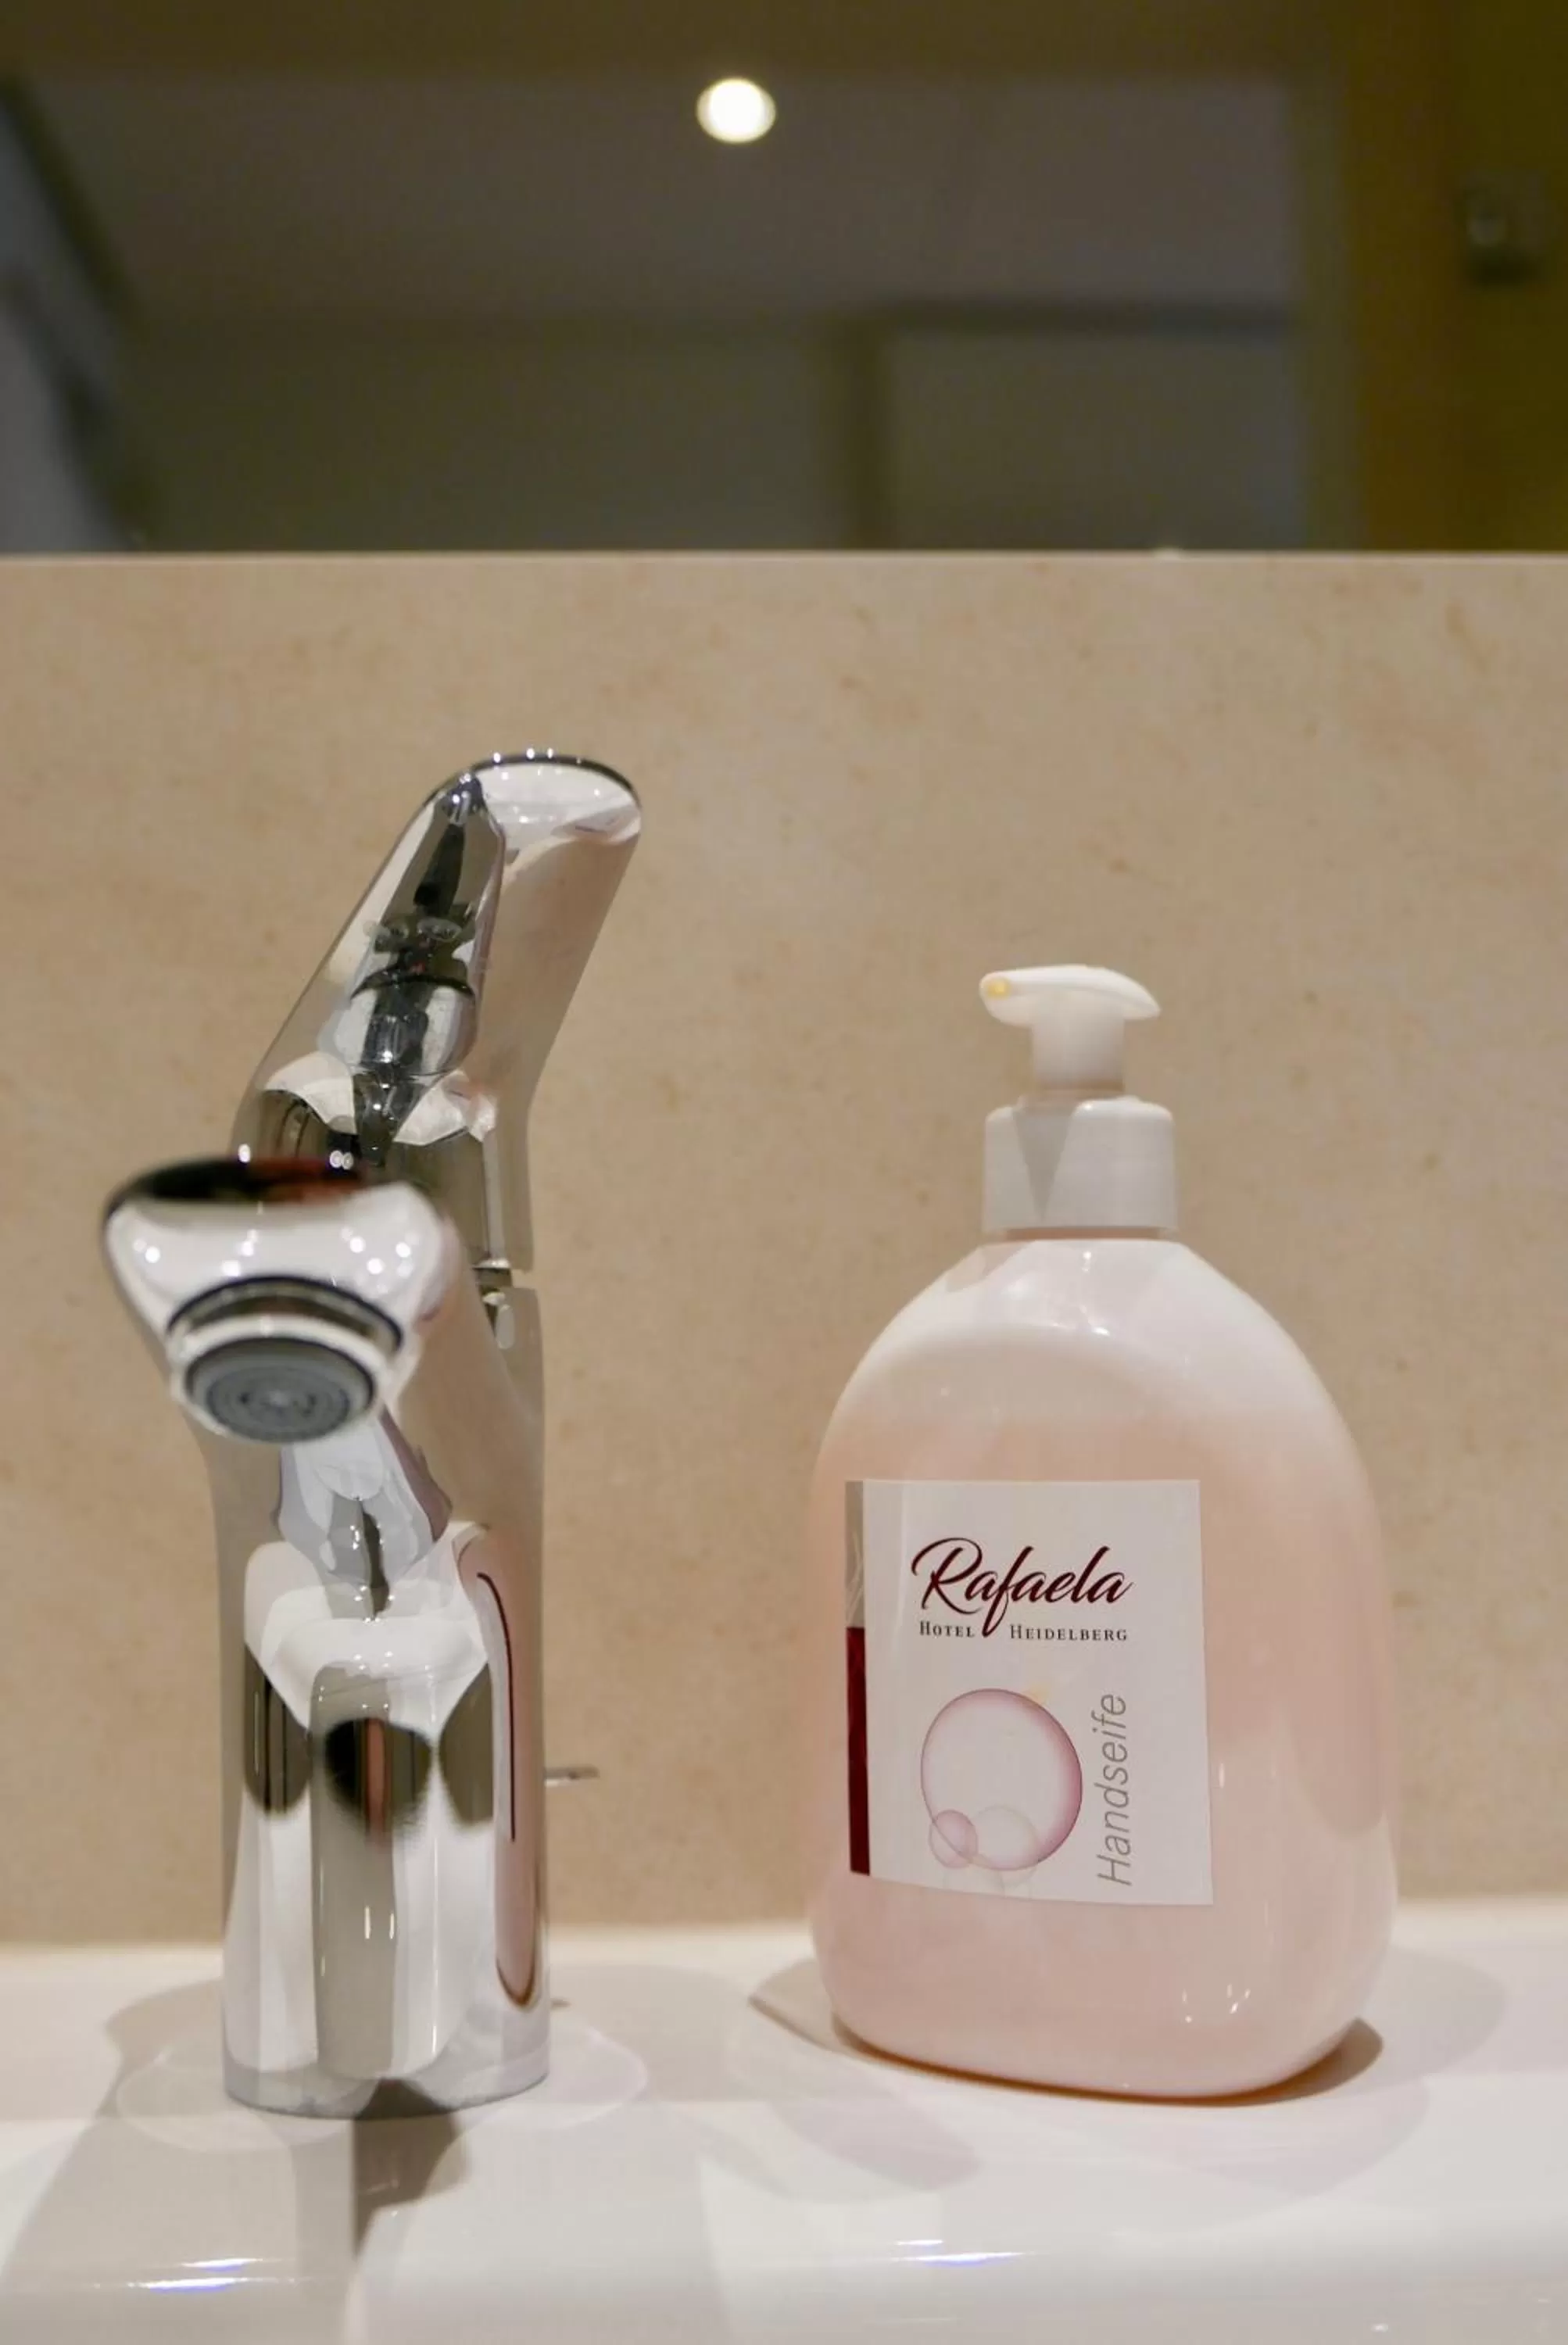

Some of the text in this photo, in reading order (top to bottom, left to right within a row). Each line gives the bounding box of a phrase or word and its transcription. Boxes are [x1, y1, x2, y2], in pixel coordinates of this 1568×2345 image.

[911, 1537, 1135, 1638] Rafaela
[919, 1620, 1128, 1642] HOTEL HEIDELBERG
[1091, 1694, 1131, 1886] Handseife
